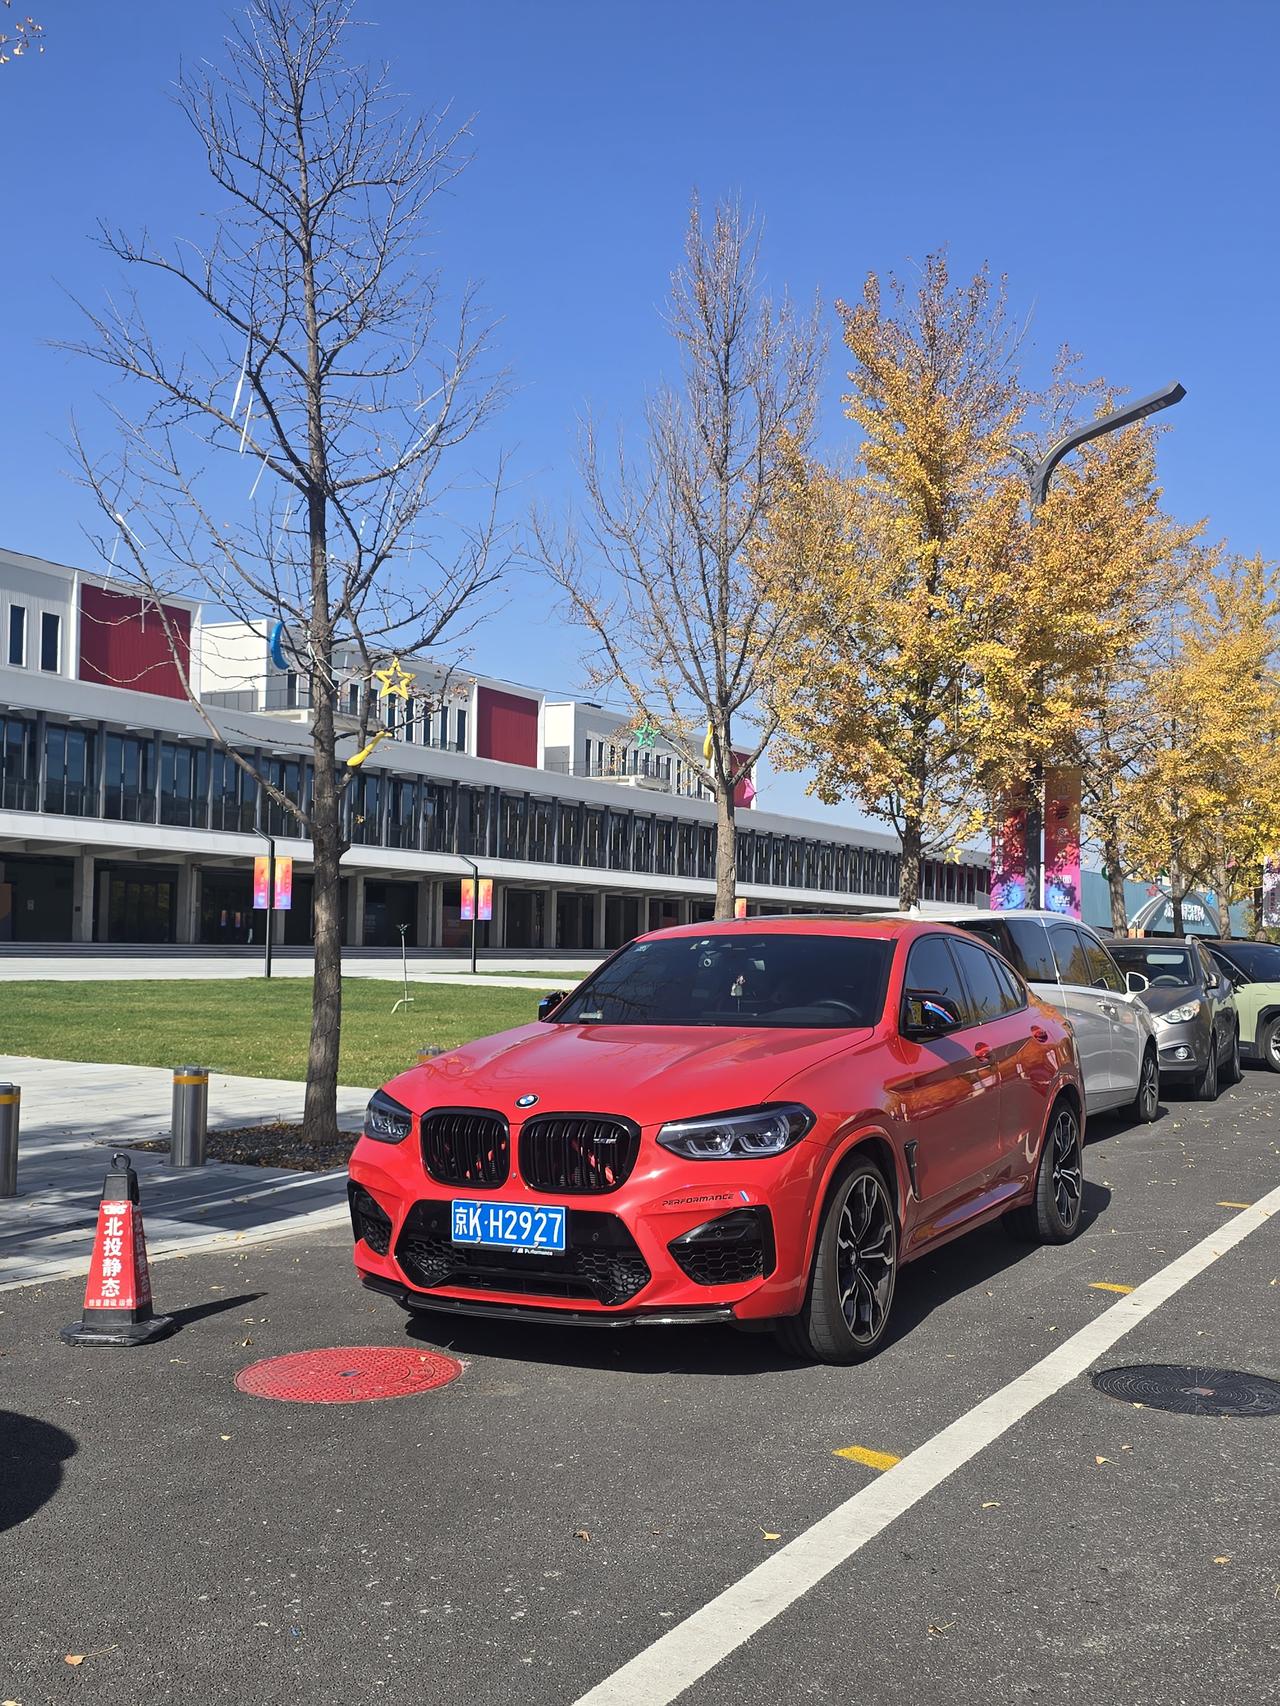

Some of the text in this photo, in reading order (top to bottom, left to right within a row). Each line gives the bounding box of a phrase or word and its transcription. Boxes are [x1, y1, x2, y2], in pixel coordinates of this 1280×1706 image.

[662, 1193, 735, 1206] PERFORMANCE
[101, 1217, 123, 1297] 北投静态
